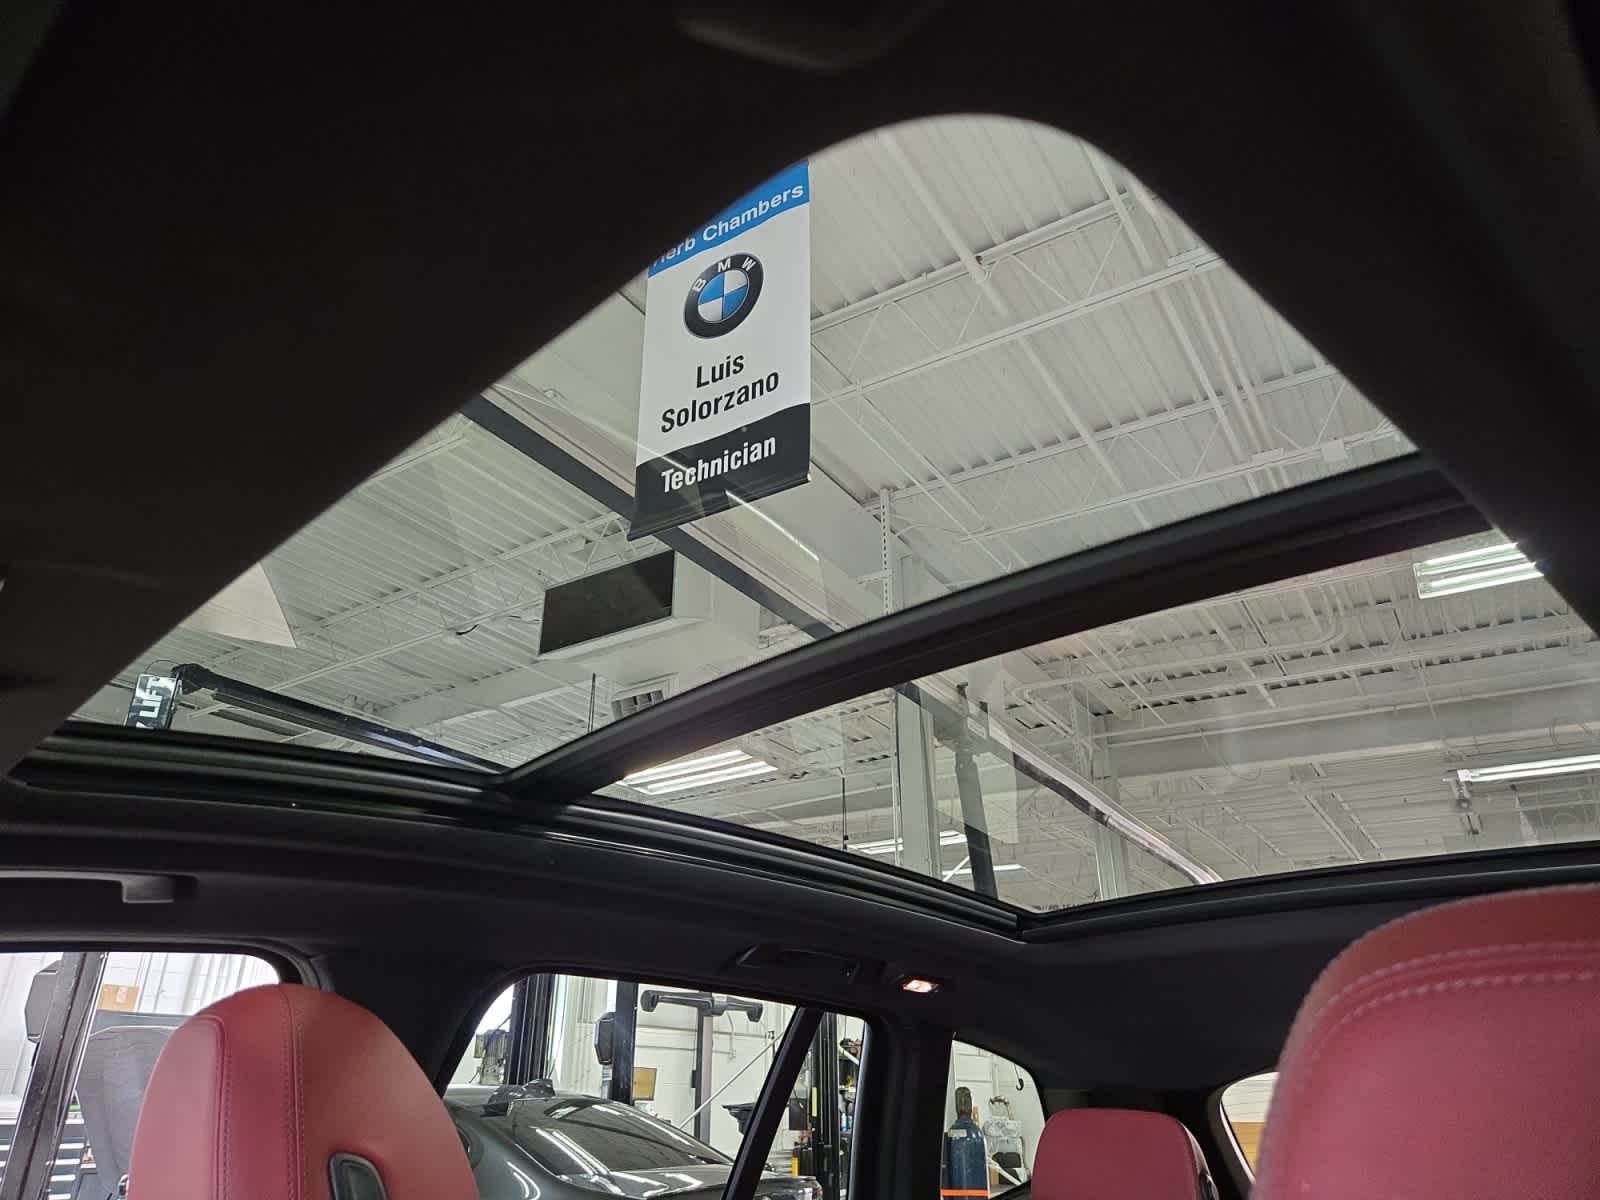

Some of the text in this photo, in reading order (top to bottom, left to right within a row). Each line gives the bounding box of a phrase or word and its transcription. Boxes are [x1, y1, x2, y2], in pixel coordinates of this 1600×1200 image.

[703, 183, 805, 241] Chambers
[691, 256, 757, 293] BMW
[696, 354, 745, 389] Luis
[661, 371, 779, 434] Solorzano
[661, 435, 776, 494] Technician
[139, 677, 164, 718] LIFT
